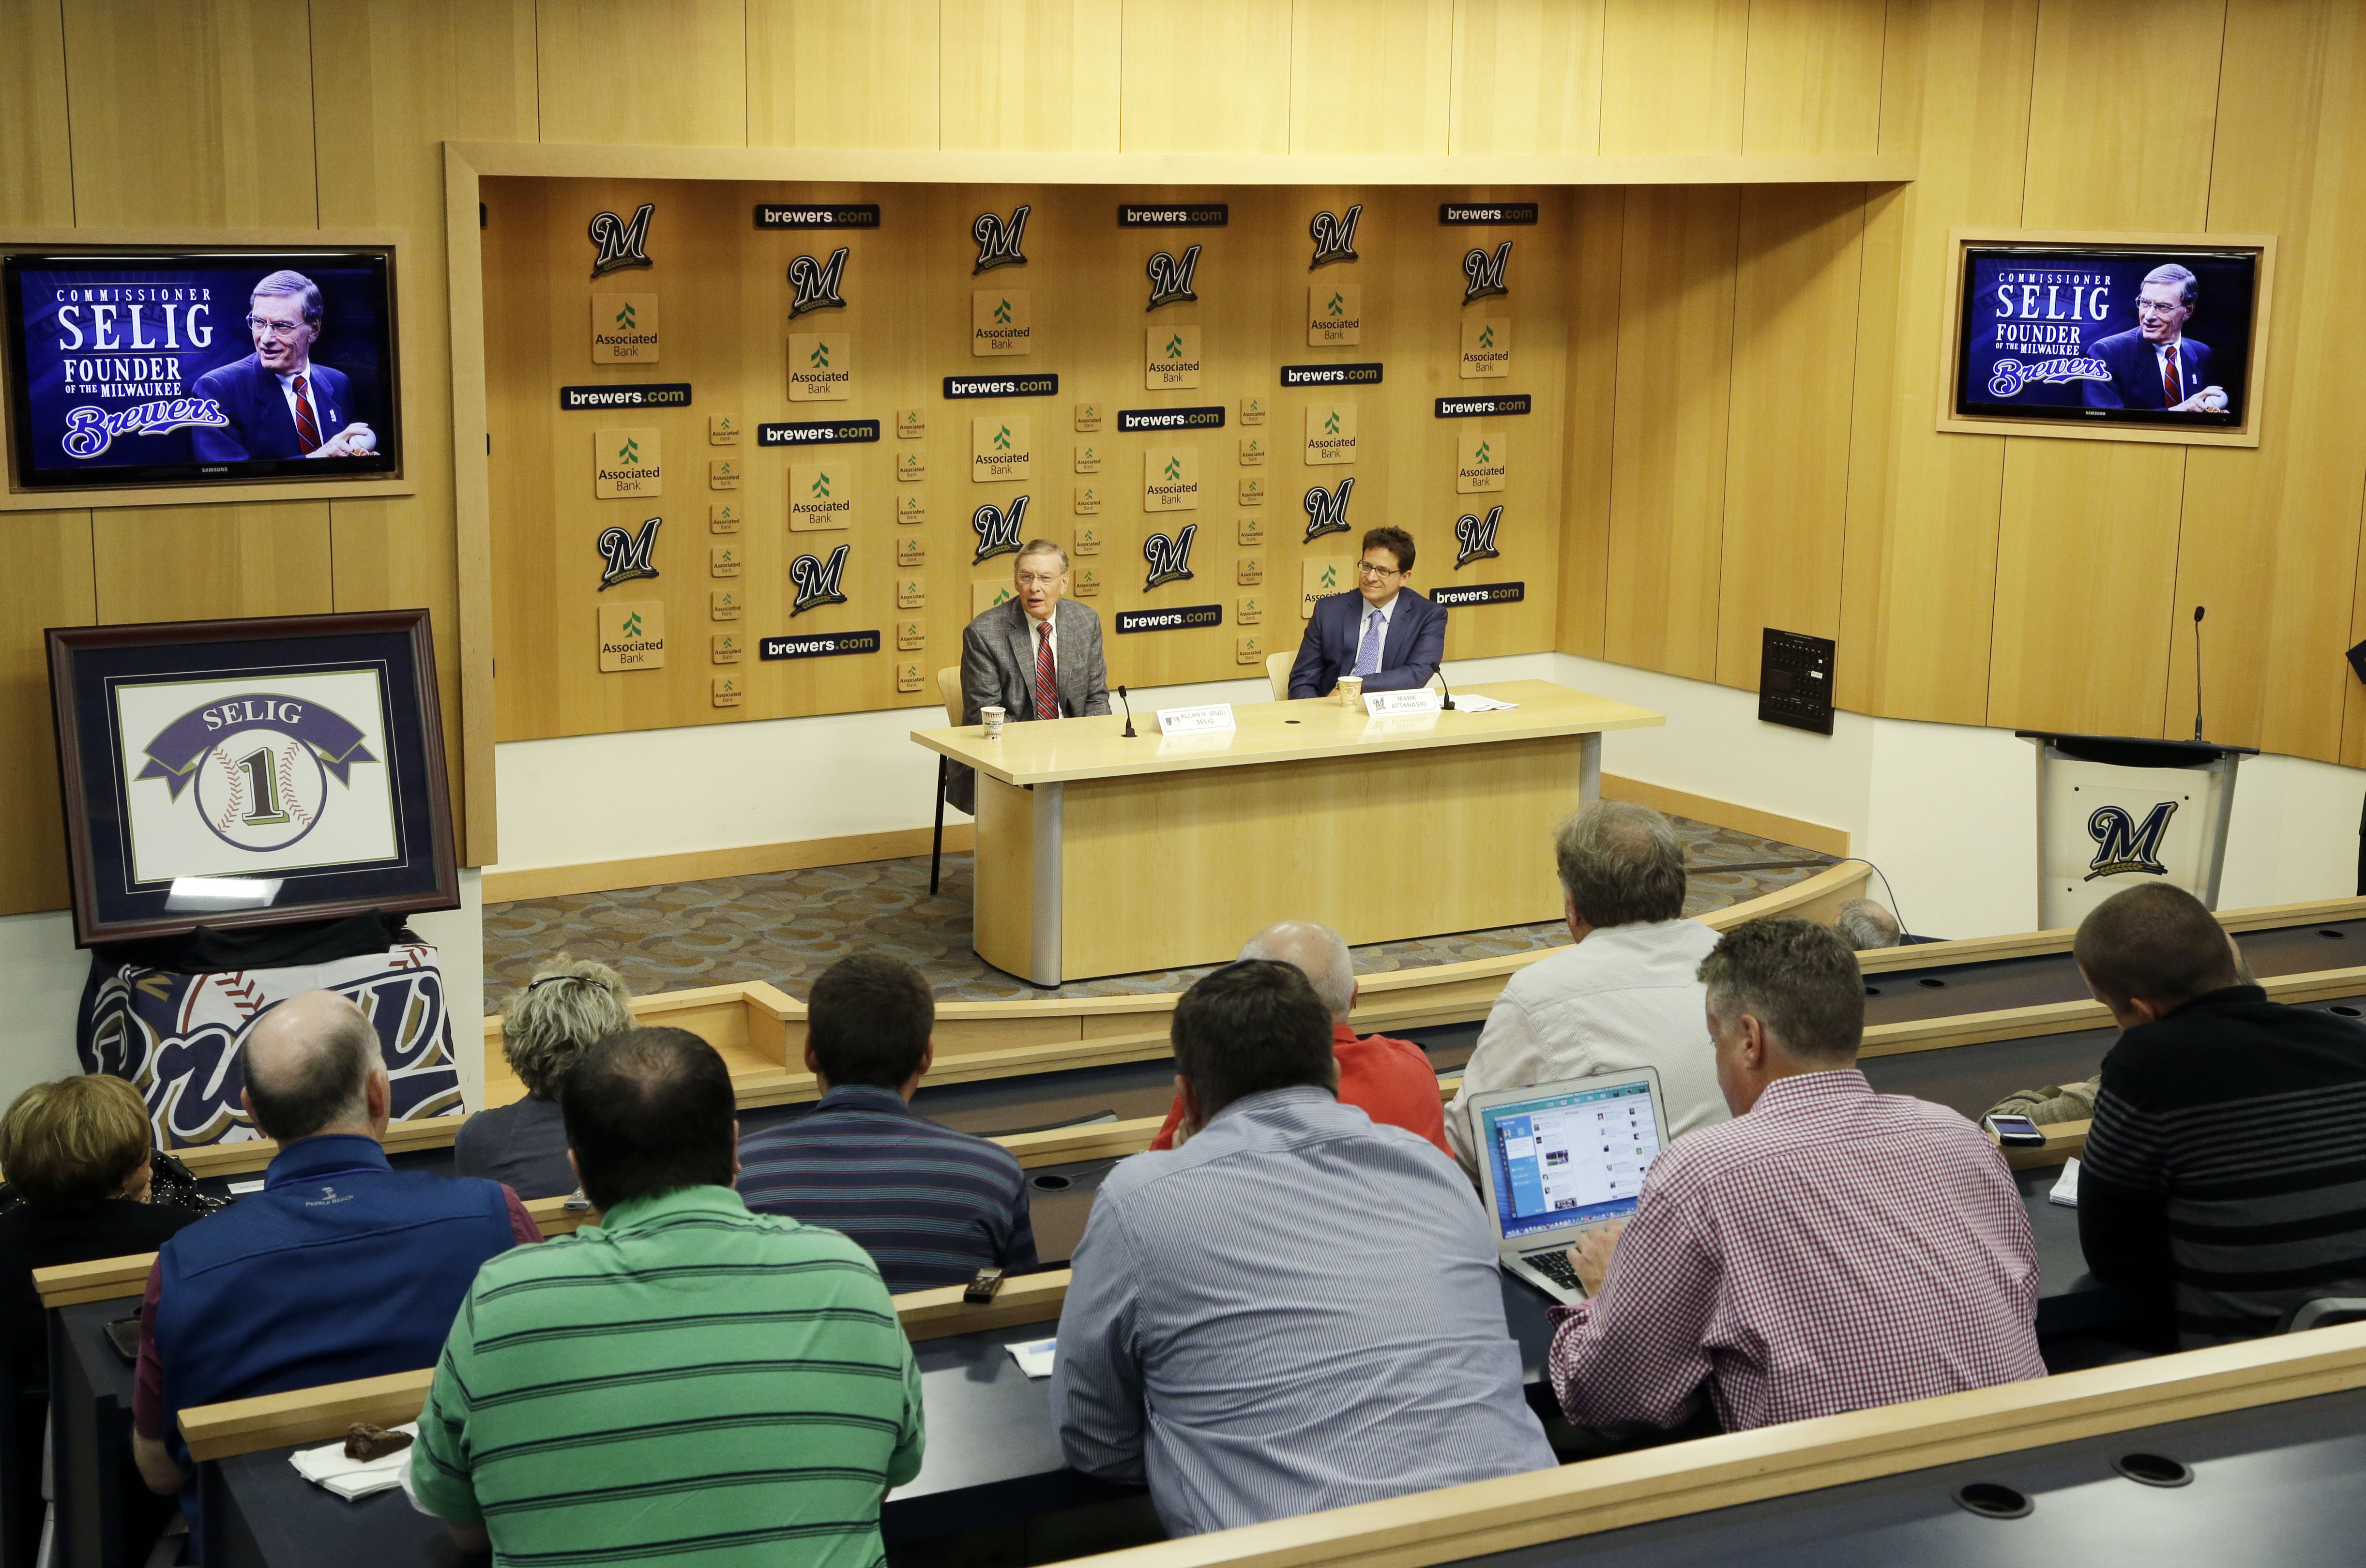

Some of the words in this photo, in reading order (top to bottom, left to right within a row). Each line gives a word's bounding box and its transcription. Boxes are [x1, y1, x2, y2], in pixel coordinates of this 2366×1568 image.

[764, 209, 872, 223] brewers.com
[1127, 209, 1222, 223] brewers.com
[1448, 208, 1532, 220] brewers.com
[589, 203, 654, 266] M
[973, 205, 1031, 263] M
[1310, 204, 1363, 259] M
[1148, 245, 1201, 302] M
[1463, 241, 1513, 295] M
[788, 247, 849, 307] M
[1999, 273, 2110, 285] COMMISSIONER
[57, 289, 211, 302] COMMISSIONER
[1996, 285, 2109, 320] SELIG
[58, 304, 213, 350] SELIG
[1311, 318, 1359, 329] Associated
[595, 333, 657, 344] Associated
[976, 327, 1030, 338] Associated
[1325, 330, 1343, 339] Bank
[1996, 324, 2080, 343] FOUNDER
[614, 346, 638, 356] Bank
[992, 339, 1013, 349] Bank
[2020, 344, 2079, 355] MILWAUKEE
[1463, 351, 1508, 362] Associated
[63, 358, 182, 382] FOUNDER
[1149, 362, 1199, 373] Associated
[1476, 362, 1493, 371] Bank
[791, 371, 848, 382] Associated
[1164, 373, 1183, 382] Bank
[1288, 368, 1377, 382] brewers.com
[1988, 358, 2112, 397] Brewers
[79, 384, 97, 393] THE
[101, 382, 182, 397] MILWAUKEE
[808, 383, 831, 393] Bank
[952, 379, 1051, 394] brewers.com
[570, 390, 684, 406] brewers.com
[1442, 399, 1526, 414] brewers.com
[1125, 412, 1219, 427] brewers.com
[62, 398, 229, 459] Brewers
[766, 425, 873, 441] brewers.com
[1308, 437, 1355, 448] Associated
[976, 452, 1029, 464] Associated
[1322, 449, 1340, 458] Bank
[599, 467, 659, 480] Associated
[991, 465, 1012, 474] Bank
[1460, 466, 1504, 477] Associated
[617, 480, 640, 491] Bank
[1147, 482, 1197, 494] Associated
[1471, 476, 1490, 486] Bank
[1161, 494, 1181, 504] Bank
[1305, 478, 1355, 530] M
[793, 500, 849, 513] Associated
[808, 512, 832, 524] Bank
[973, 495, 1029, 554] M
[1455, 505, 1503, 559] M
[598, 517, 662, 578] M
[1144, 524, 1197, 581] M
[791, 544, 850, 605] M
[1437, 587, 1519, 604] brewers.com
[1123, 610, 1216, 629] brewers.com
[603, 639, 663, 653] Associated
[769, 635, 873, 654] brewers.com
[620, 652, 644, 663] Bank
[202, 700, 302, 731] SELIG
[235, 747, 290, 826] 1
[2088, 801, 2179, 871] M
[332, 1195, 353, 1204] BEACH
